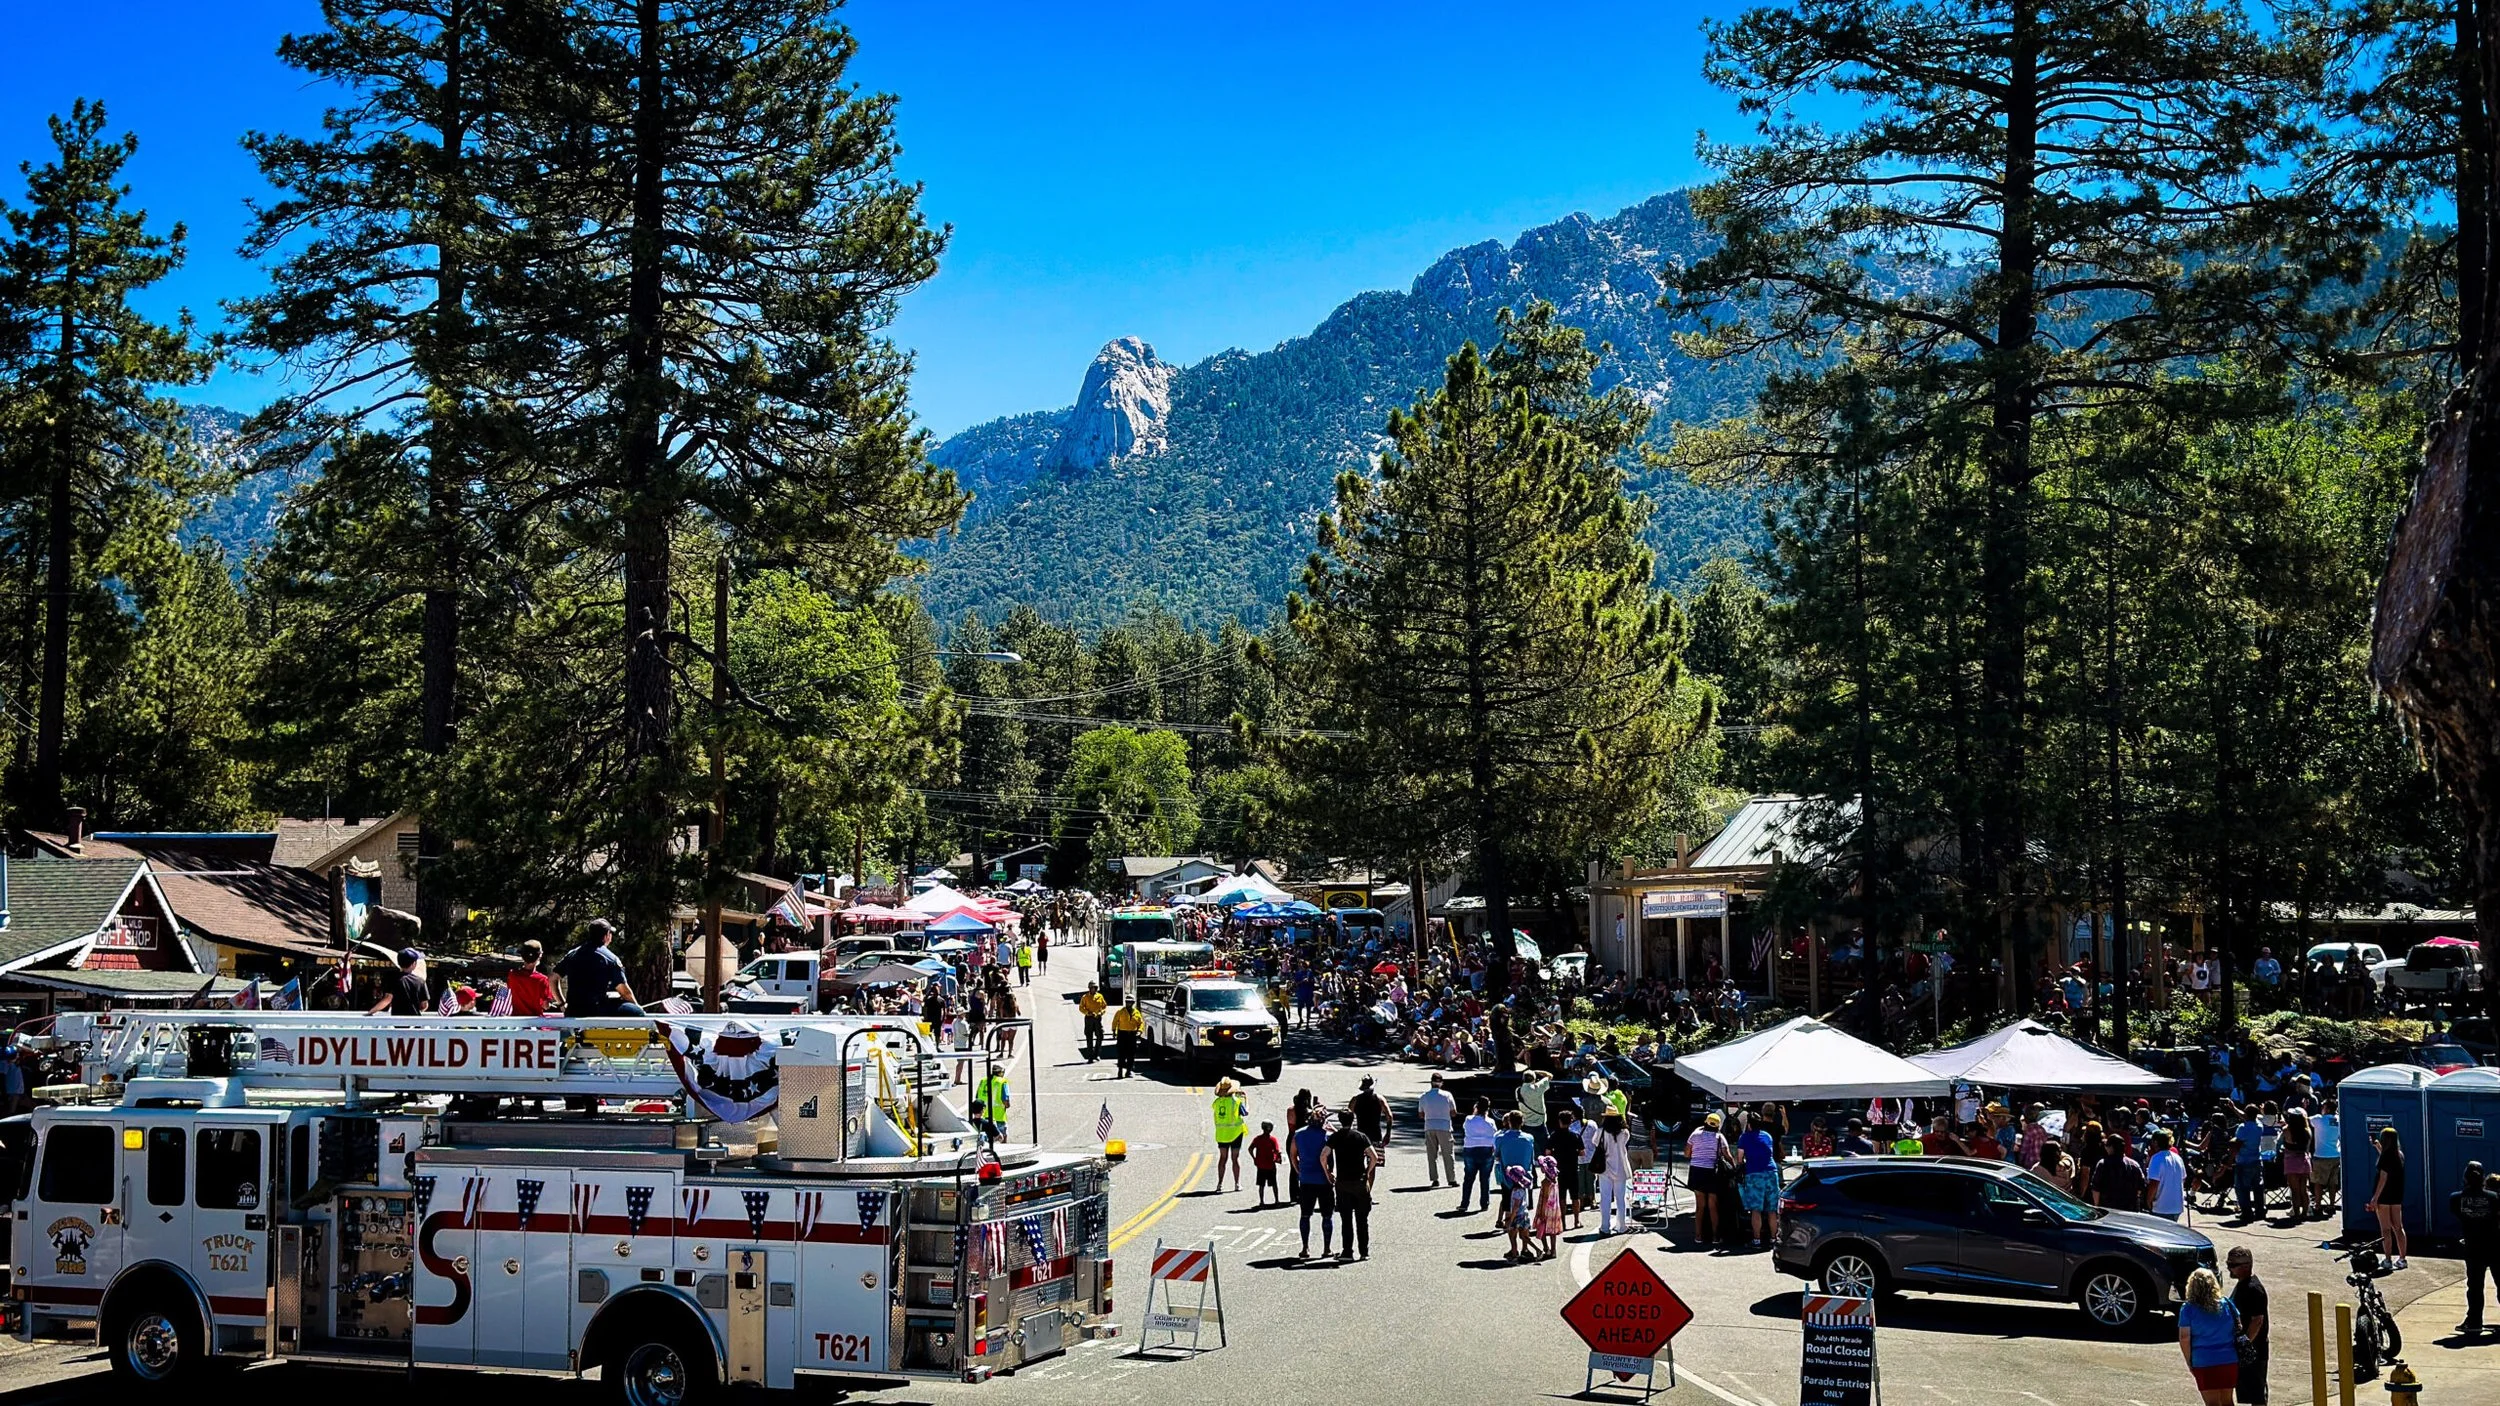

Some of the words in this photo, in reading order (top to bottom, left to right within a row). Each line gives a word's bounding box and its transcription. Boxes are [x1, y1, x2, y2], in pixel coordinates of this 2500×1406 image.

[99, 929, 122, 945] GIFT
[124, 928, 151, 947] SHOP
[297, 1036, 469, 1068] IDYLLWILD
[480, 1038, 557, 1069] FIRE
[202, 1234, 256, 1254] TRUCK
[209, 1254, 248, 1272] T621
[1031, 1262, 1052, 1283] T621
[1604, 1281, 1652, 1297] ROAD
[1592, 1304, 1661, 1320] CLOSED
[1597, 1328, 1656, 1344] AHEAD
[1815, 1335, 1828, 1343] July
[1840, 1336, 1862, 1344] Parade
[815, 1332, 870, 1363] T621
[1806, 1343, 1833, 1354] Road
[1834, 1345, 1871, 1357] Closed
[1602, 1361, 1641, 1370] RIVERSIDE
[1803, 1376, 1835, 1387] Parade
[1836, 1378, 1870, 1390] Entries
[1823, 1389, 1845, 1399] ONLY
